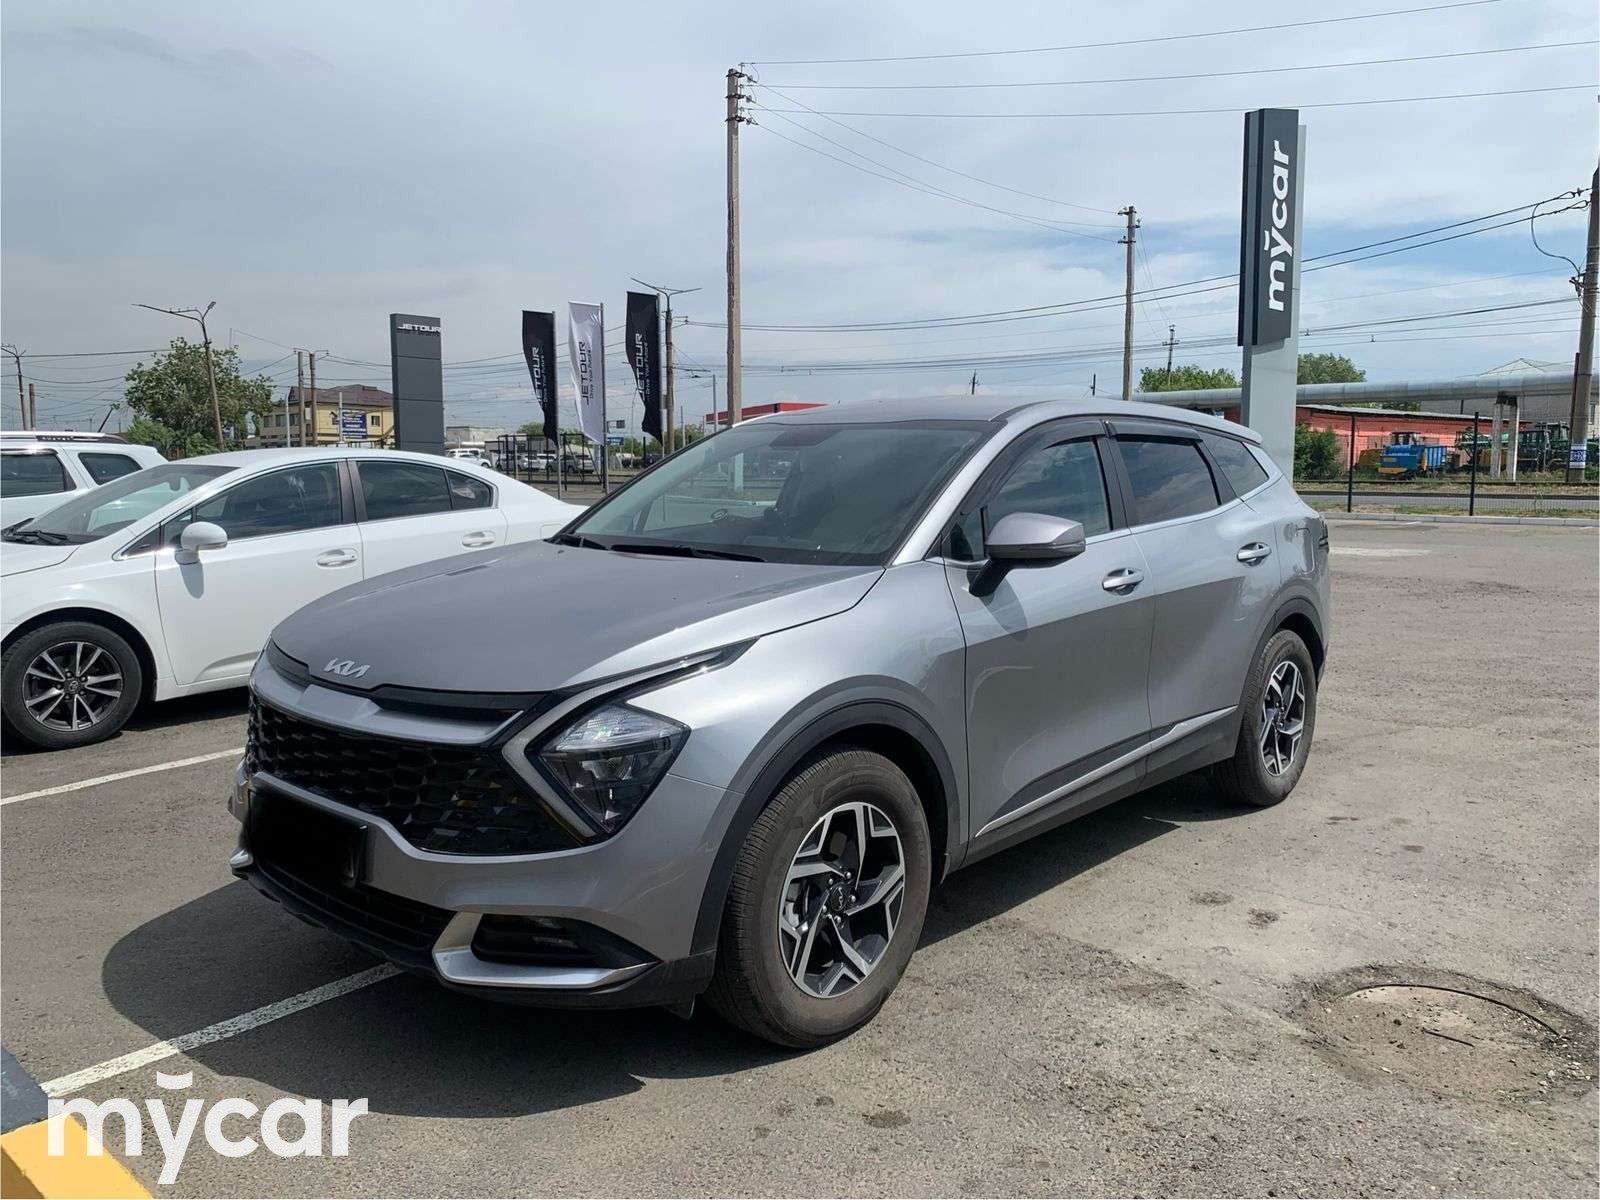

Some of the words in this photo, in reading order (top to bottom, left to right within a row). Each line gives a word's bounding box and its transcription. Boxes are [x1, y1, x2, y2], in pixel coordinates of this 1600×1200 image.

[397, 323, 441, 332] JETOUR
[579, 341, 589, 406] JETOUR
[635, 333, 645, 401] JETOUR
